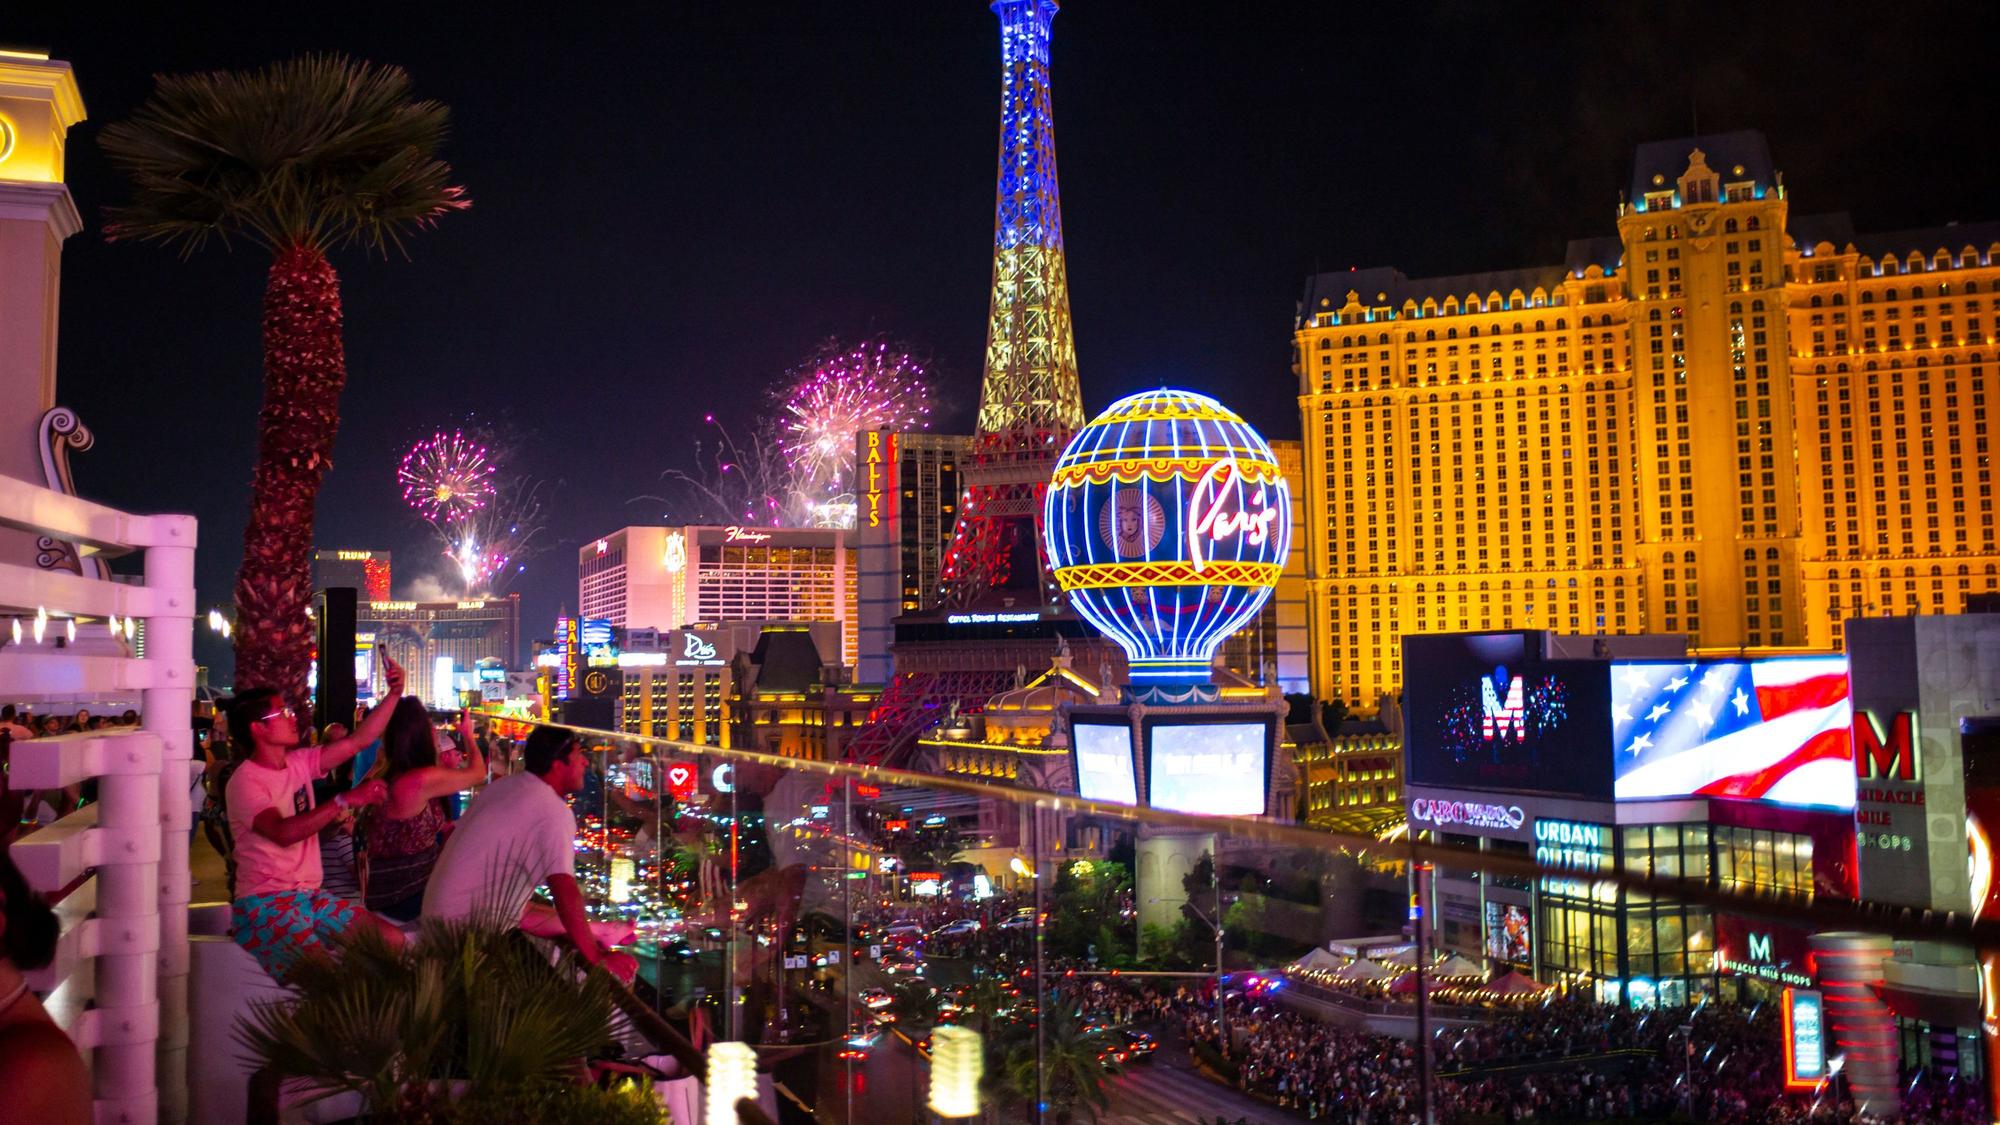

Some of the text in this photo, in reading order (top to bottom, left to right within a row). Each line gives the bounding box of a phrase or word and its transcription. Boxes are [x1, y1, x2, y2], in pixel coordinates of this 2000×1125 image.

[1189, 457, 1277, 573] Paris
[724, 526, 771, 544] Flamingo
[338, 551, 371, 560] TRUMP
[370, 601, 485, 610] TREASURE ISLAND
[1481, 676, 1524, 741] M
[1853, 711, 1920, 782] M
[1857, 789, 1925, 806] MIRACLE
[1857, 811, 1891, 825] MILE
[1535, 821, 1599, 847] URBAN
[1857, 832, 1911, 851] SHOPS
[1748, 932, 1771, 962] M
[1723, 960, 1811, 987] MIRACLE MILE SHOPS
